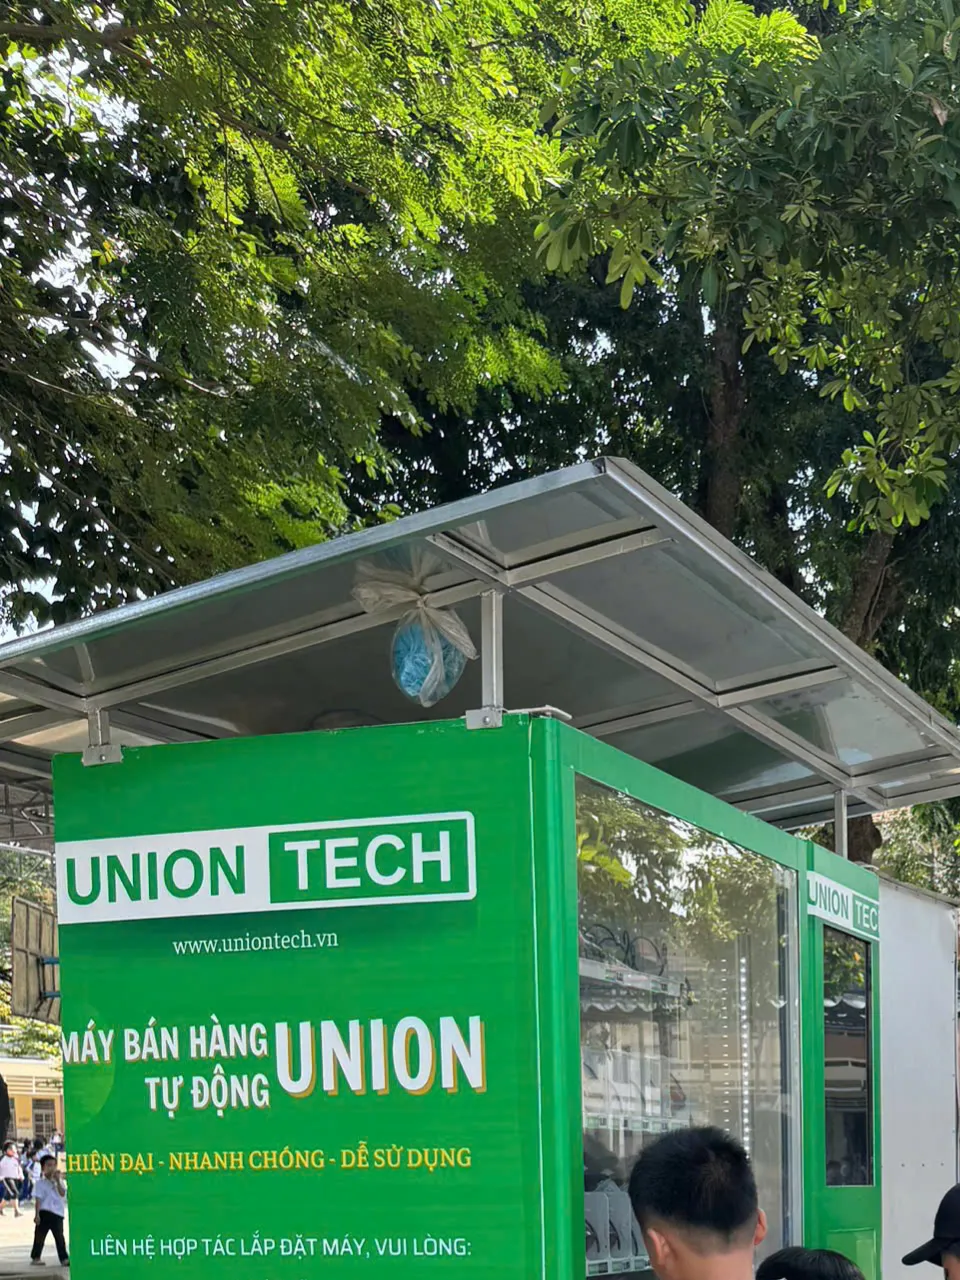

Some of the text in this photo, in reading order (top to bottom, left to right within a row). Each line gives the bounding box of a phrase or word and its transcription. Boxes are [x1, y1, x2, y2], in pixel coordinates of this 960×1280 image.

[66, 831, 451, 906] UNION TECH
[808, 880, 849, 920] UNION
[173, 929, 339, 956] www.uniontech.vn
[61, 1013, 268, 1063] MÁY BÁN HÀNG
[275, 1015, 486, 1097] UNION
[145, 1063, 269, 1118] TỰ ĐỘNG
[67, 1149, 115, 1176] HIỆN
[120, 1152, 154, 1175] ĐẠI
[169, 1151, 244, 1172] NHANH
[249, 1146, 325, 1170] CHÓNG
[407, 1147, 472, 1173] DỤNG
[91, 1230, 471, 1260] LIÊN HỆ HỢP TÁC LẮP ĐẶT MÁY, VUI LÒNG:
